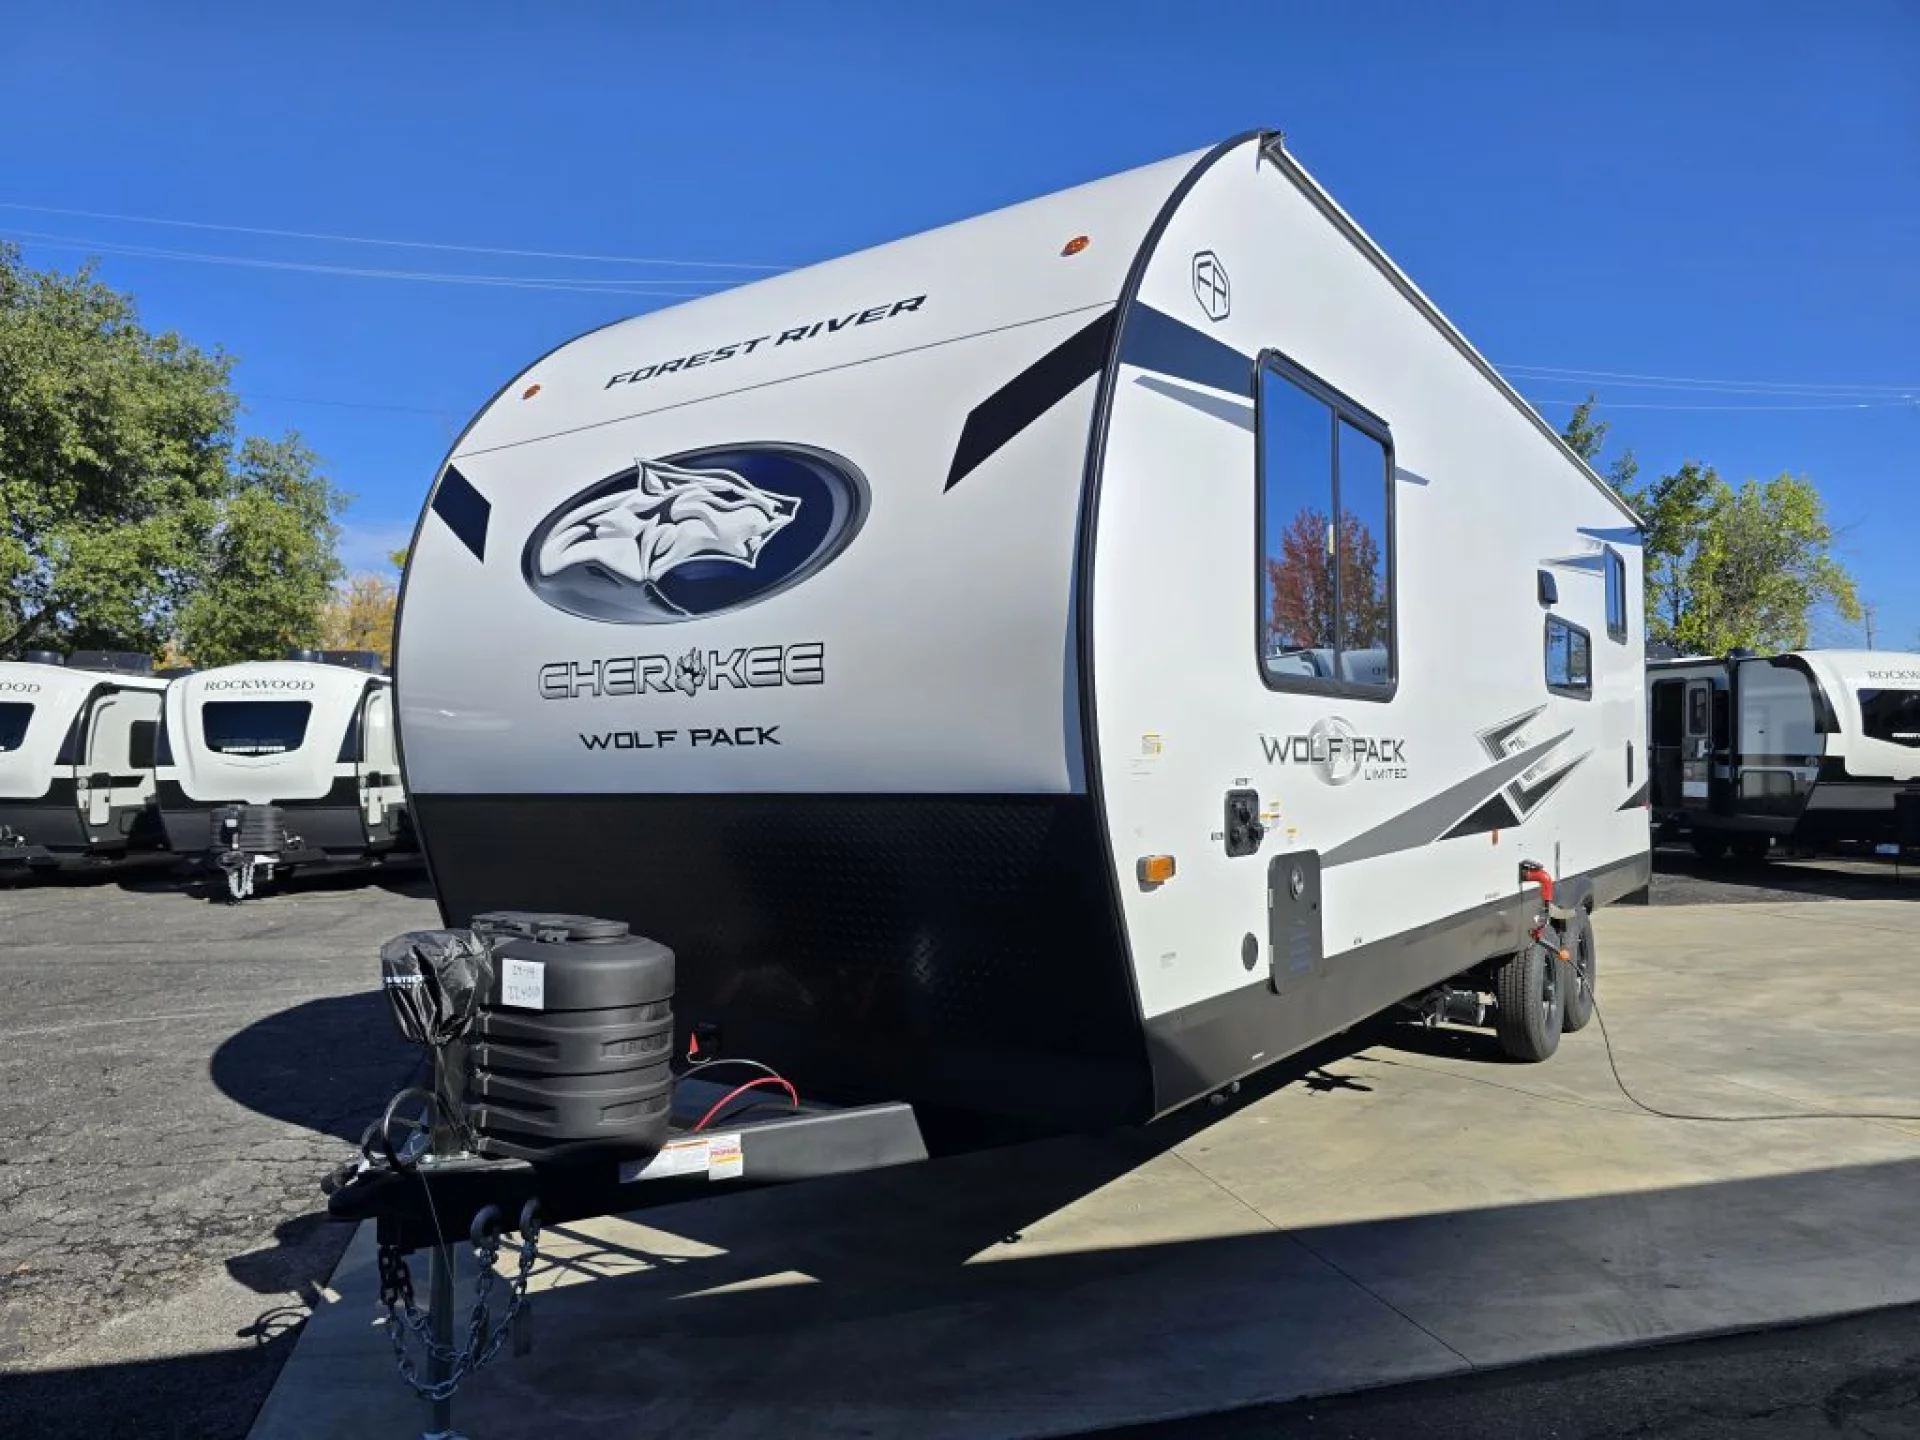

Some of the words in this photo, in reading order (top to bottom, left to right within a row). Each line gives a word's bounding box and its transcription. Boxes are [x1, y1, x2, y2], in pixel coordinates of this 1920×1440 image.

[604, 335, 771, 390] FOREST
[775, 294, 927, 347] RIVER
[204, 680, 315, 690] ROCKWOOD
[579, 730, 678, 751] WOLF
[688, 725, 782, 747] PACK
[1259, 736, 1343, 764] WOLF
[1352, 737, 1407, 763] PACK
[1365, 768, 1408, 780] LIMITED
